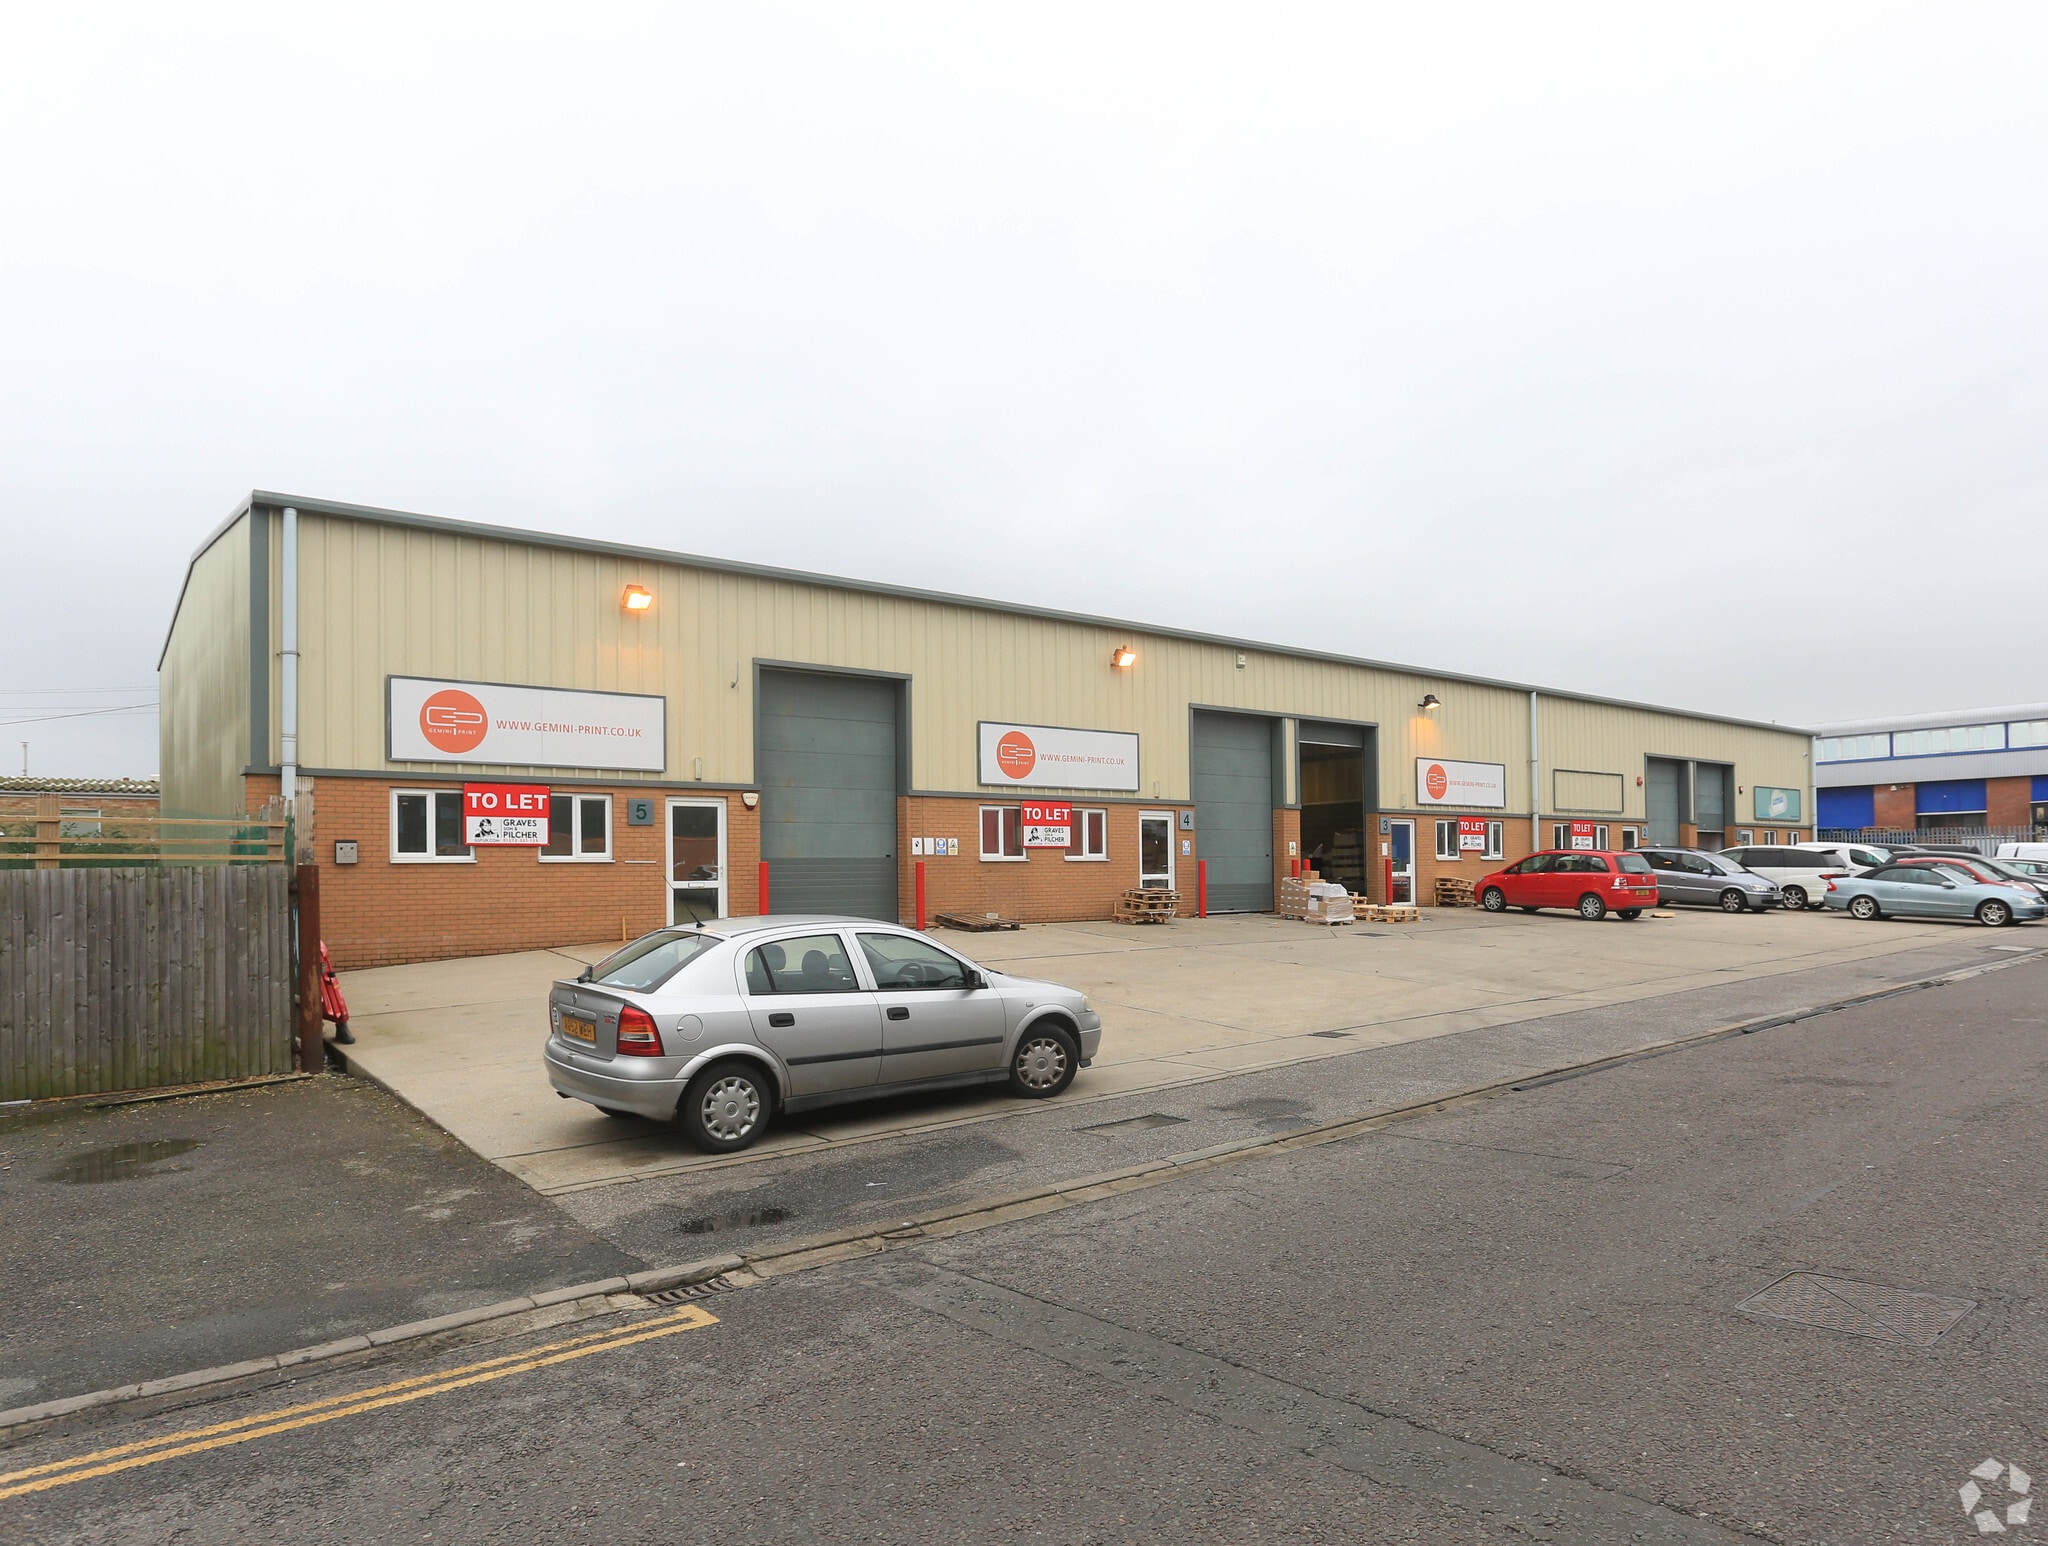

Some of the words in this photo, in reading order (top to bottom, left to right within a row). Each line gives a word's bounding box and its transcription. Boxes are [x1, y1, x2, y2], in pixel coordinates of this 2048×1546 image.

[496, 719, 642, 738] WWW.GEMINI-PRINT.CO.UK
[1040, 753, 1125, 766] WWW.GEMINI-PRINT.CO.UK
[467, 792, 499, 809] TO
[505, 793, 548, 810] LET
[635, 804, 647, 820] 5
[1024, 807, 1042, 820] TO
[1045, 808, 1070, 821] LET
[503, 818, 537, 827] GRAVES
[1183, 814, 1190, 826] 4
[1383, 820, 1388, 830] 3
[1460, 821, 1470, 831] TO
[1471, 822, 1484, 832] LET
[1573, 823, 1580, 832] TO
[1581, 824, 1591, 833] LET
[503, 831, 538, 839] PILCHER
